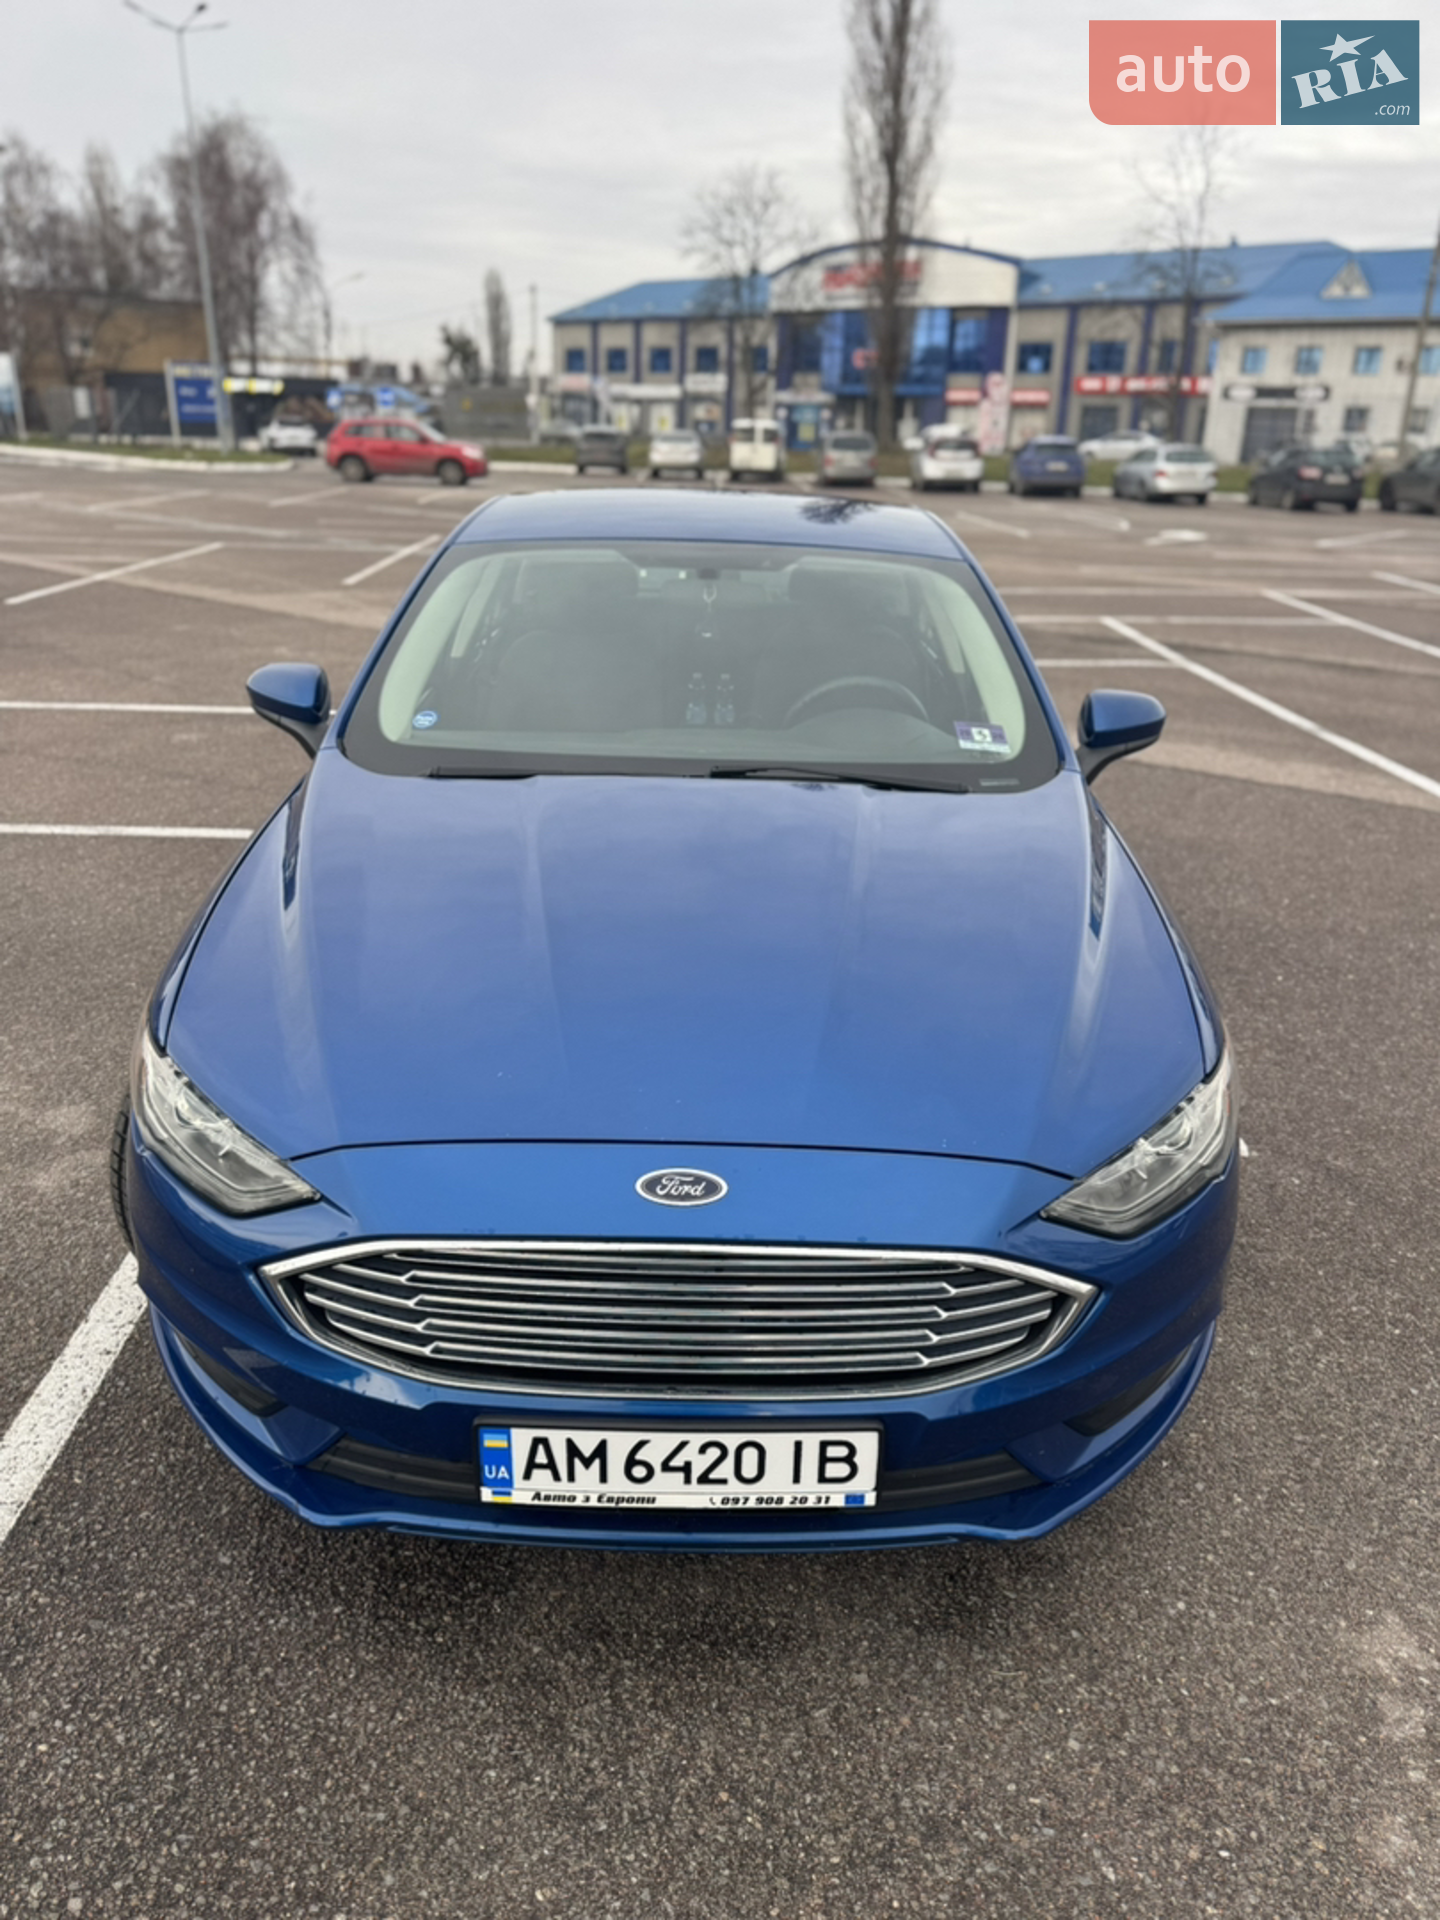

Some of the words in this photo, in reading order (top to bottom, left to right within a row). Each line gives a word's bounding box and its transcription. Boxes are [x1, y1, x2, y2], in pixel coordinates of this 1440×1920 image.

[656, 1175, 706, 1196] Ford
[522, 1436, 608, 1484] AM
[624, 1439, 766, 1485] 6420
[792, 1440, 858, 1485] IB
[484, 1465, 510, 1479] UA
[531, 1492, 577, 1503] Авто
[720, 1496, 750, 1505] 097
[755, 1496, 784, 1505] 908
[789, 1496, 808, 1505] 20
[812, 1496, 831, 1504] 31
